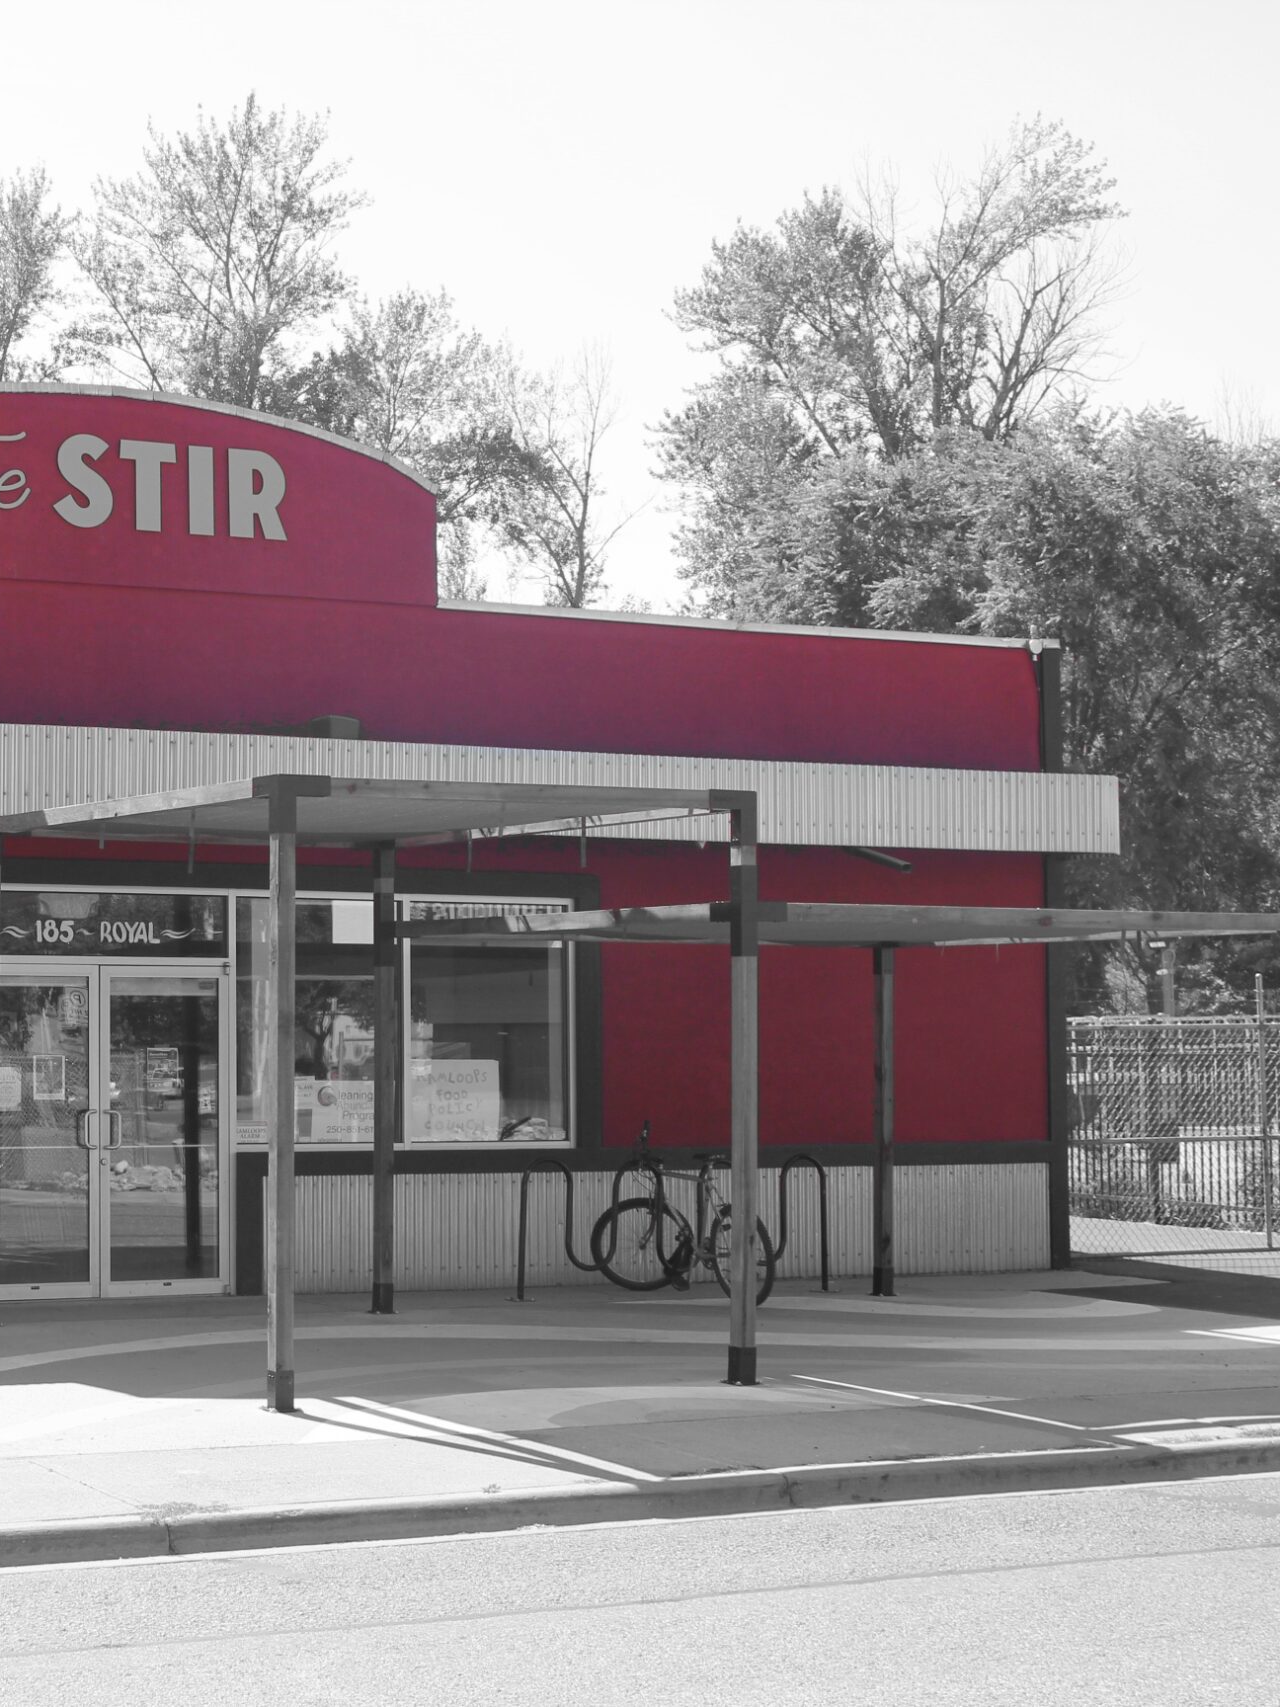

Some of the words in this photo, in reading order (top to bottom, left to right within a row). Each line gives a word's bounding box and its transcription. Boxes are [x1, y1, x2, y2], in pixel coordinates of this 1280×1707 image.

[53, 433, 288, 541] STIR
[35, 919, 75, 943] 185
[100, 920, 161, 944] ROYAL
[436, 1089, 468, 1102] FOOD
